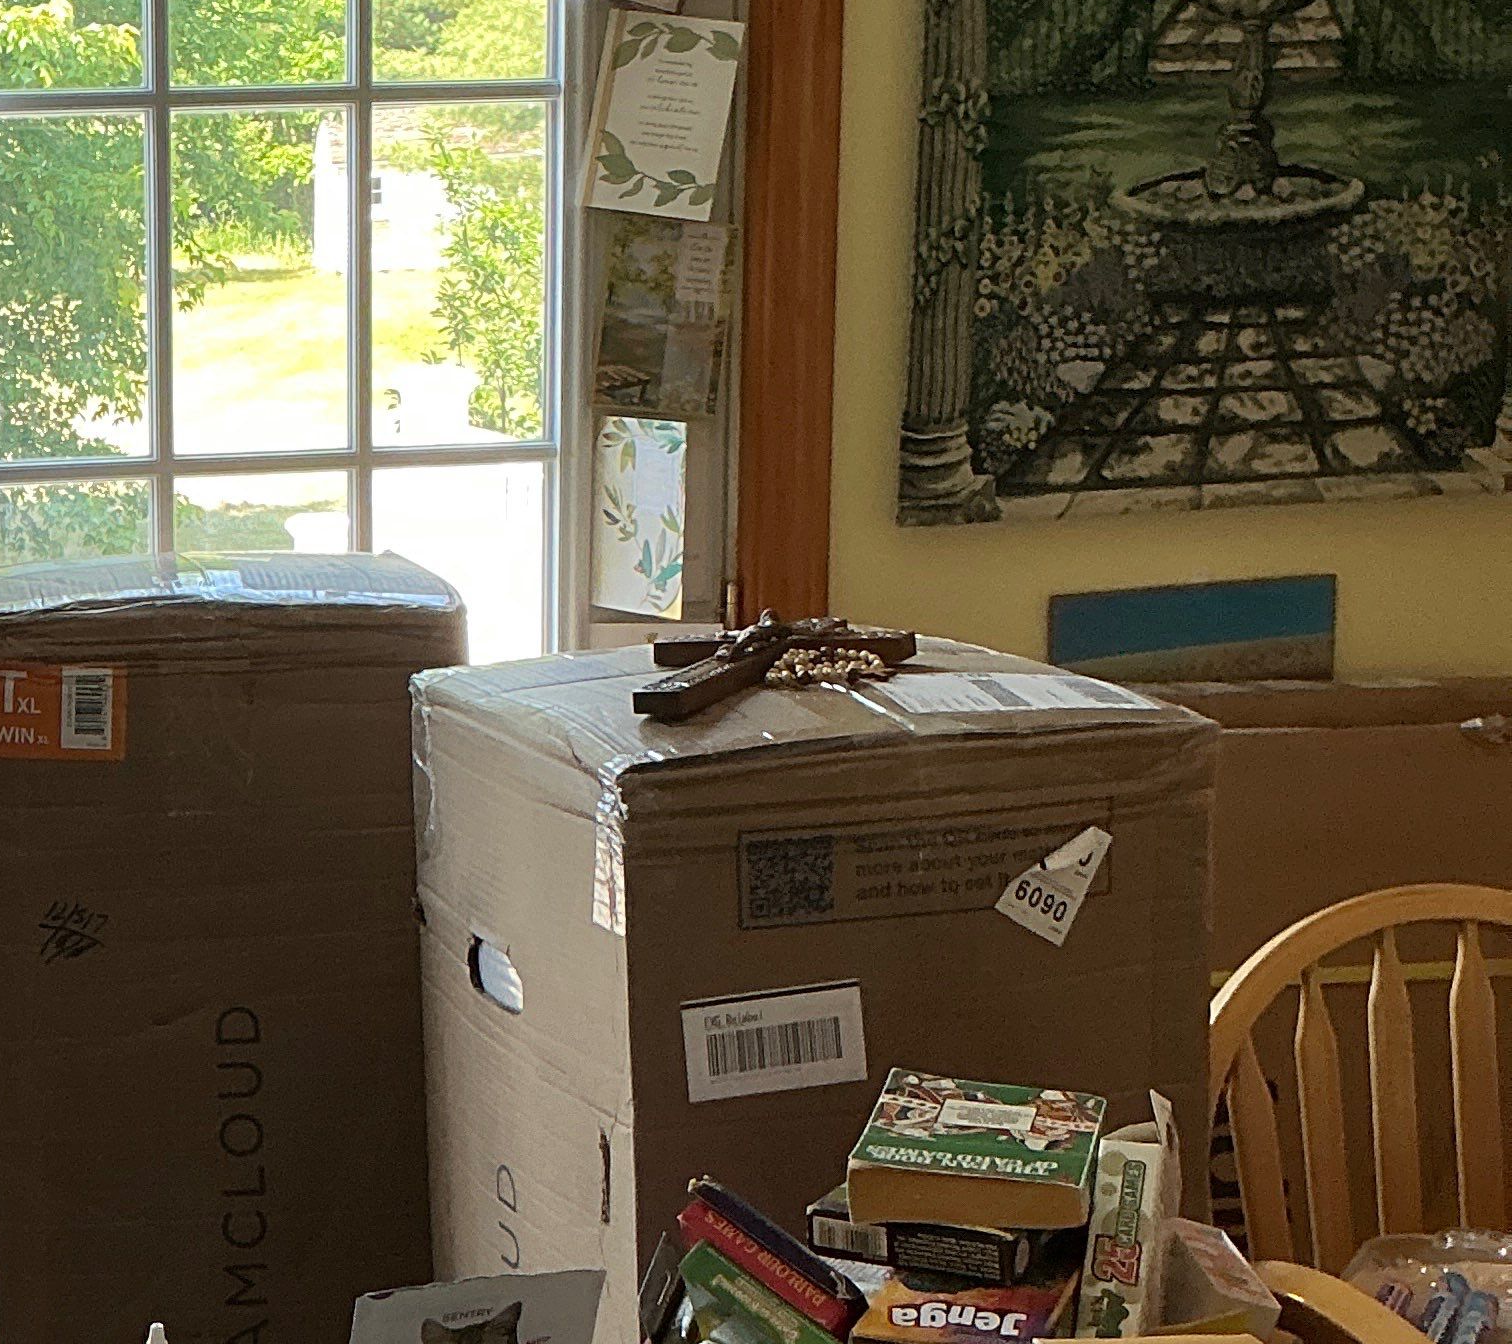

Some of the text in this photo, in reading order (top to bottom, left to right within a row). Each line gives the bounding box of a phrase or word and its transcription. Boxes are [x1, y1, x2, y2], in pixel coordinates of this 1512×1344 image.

[17, 697, 42, 715] XL
[1014, 878, 1068, 923] 6090
[1122, 1161, 1144, 1202] GAMES
[703, 1210, 758, 1258] GAMES
[754, 1250, 829, 1306] PARLOUR
[891, 1301, 1029, 1339] Jenga
